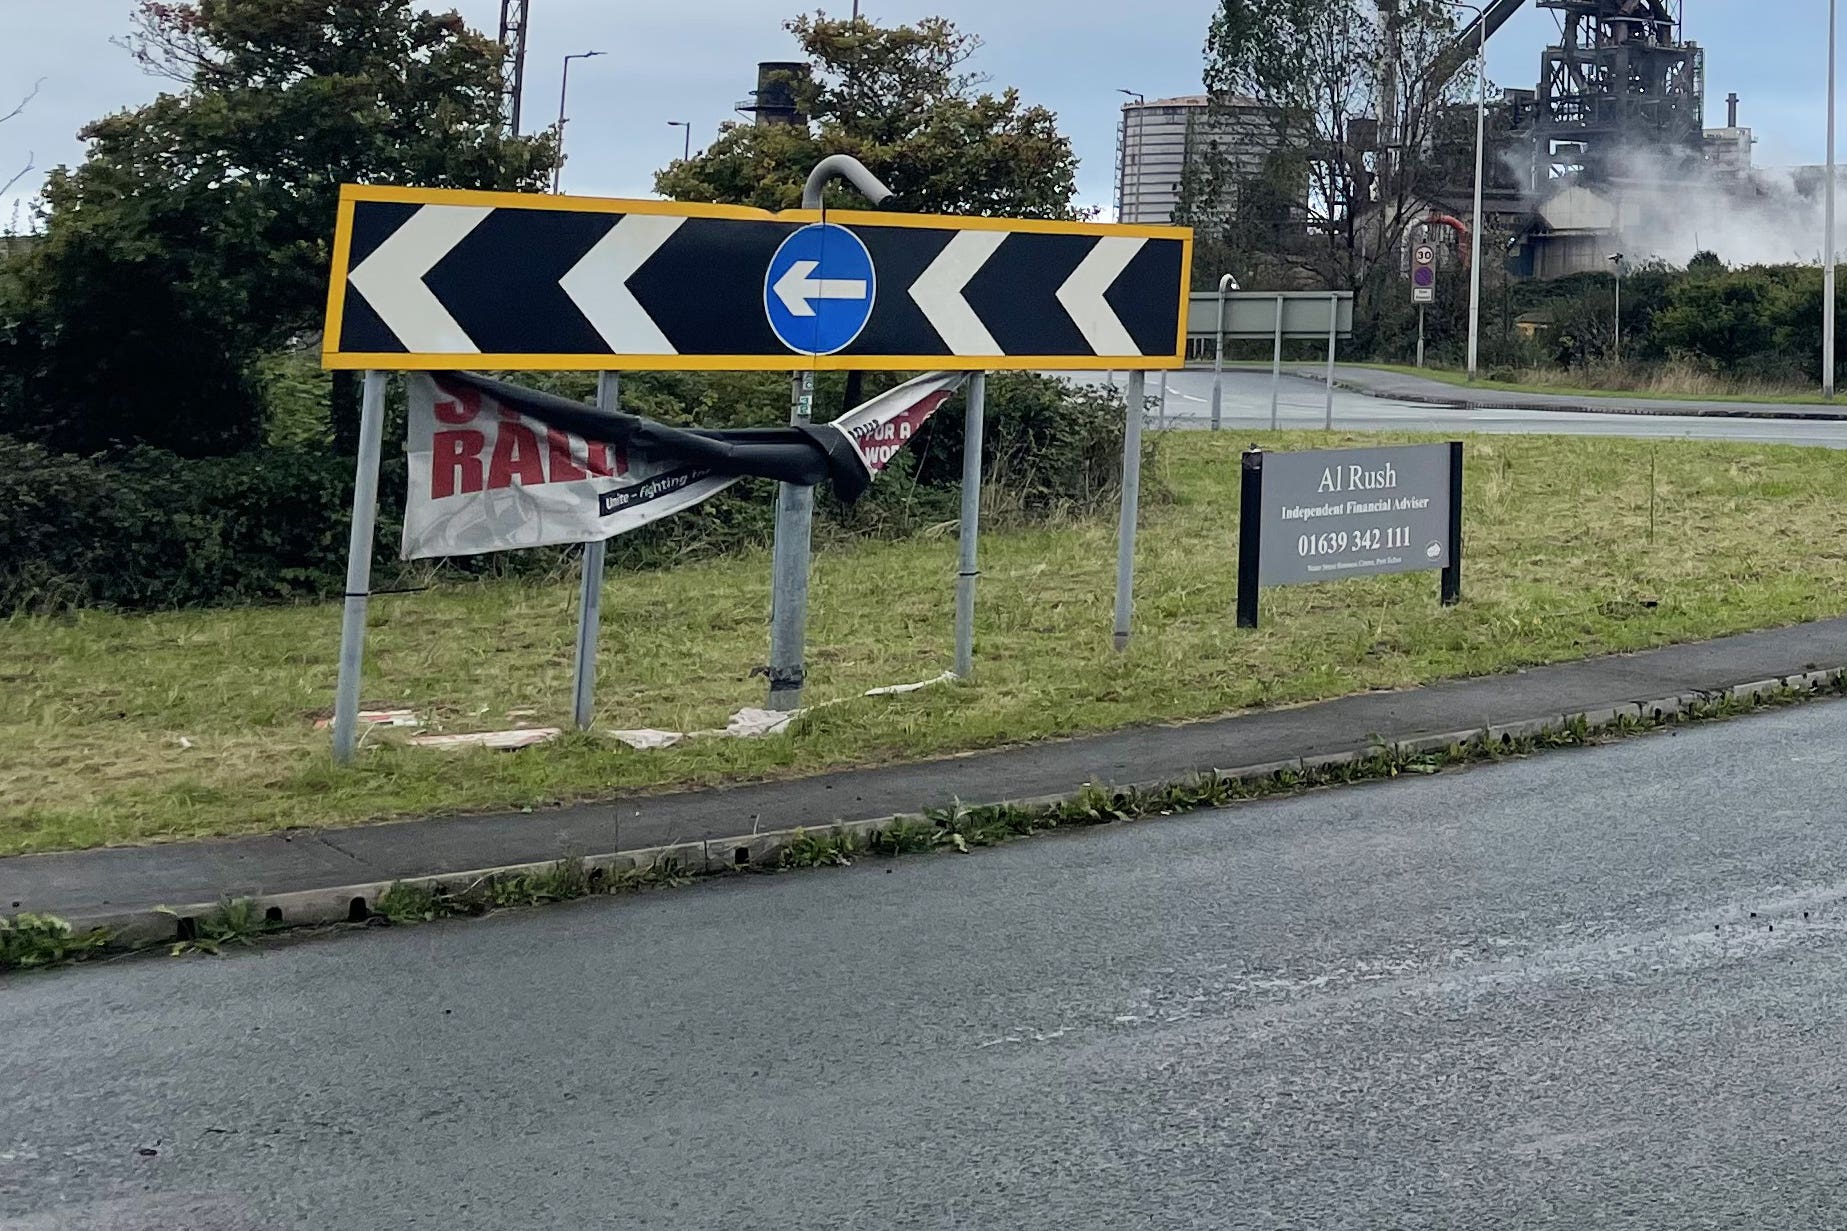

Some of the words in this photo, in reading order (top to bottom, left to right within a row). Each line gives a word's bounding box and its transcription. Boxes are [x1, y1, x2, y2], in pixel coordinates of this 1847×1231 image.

[1417, 251, 1432, 260] 30
[899, 422, 912, 438] A
[1317, 466, 1342, 493] Al
[1349, 462, 1396, 490] Rush
[605, 493, 629, 510] Unite
[640, 474, 688, 498] fighting
[1281, 505, 1344, 521] Independent
[1346, 498, 1391, 514] Financial
[1392, 496, 1429, 509] Adviser
[1298, 531, 1348, 557] 01639
[1352, 528, 1381, 552] 342
[1386, 526, 1410, 548] 111
